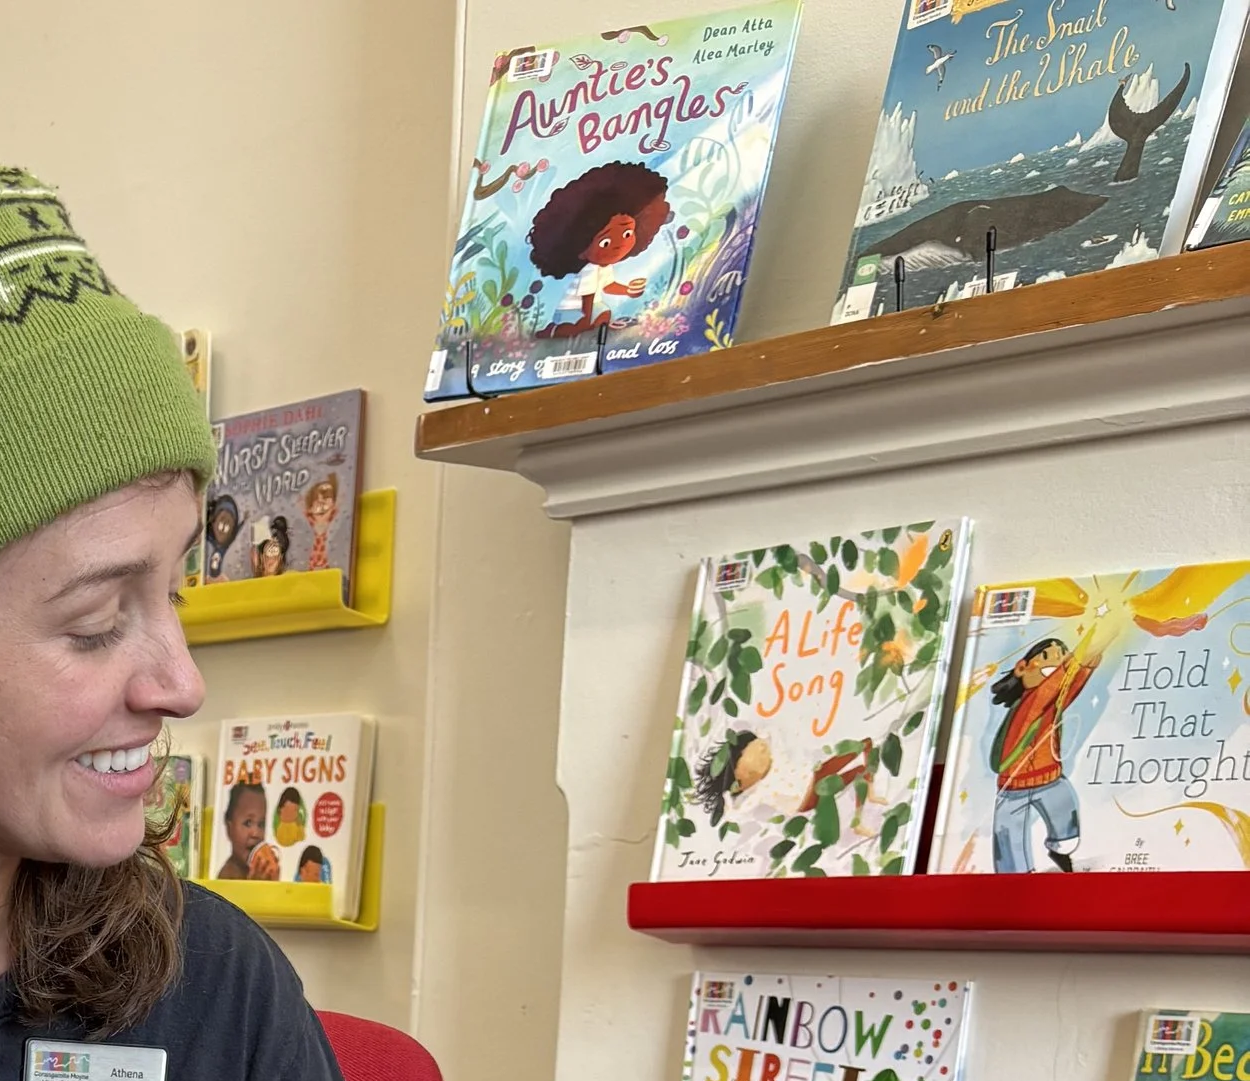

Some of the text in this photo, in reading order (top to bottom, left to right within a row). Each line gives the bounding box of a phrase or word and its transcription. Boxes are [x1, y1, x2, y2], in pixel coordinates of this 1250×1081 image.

[703, 18, 773, 42] Dean Atta
[986, 0, 1107, 65] The Snail
[692, 39, 774, 64] Alea Marley
[945, 27, 1139, 120] and the Whale
[500, 56, 672, 155] Auntie's
[578, 74, 740, 154] Bangles
[606, 338, 679, 361] and loss
[486, 359, 526, 381] story
[255, 469, 310, 507] WORLD
[763, 600, 864, 659] A Life
[1117, 649, 1212, 692] Hold
[756, 662, 844, 737] Song
[1131, 701, 1217, 740] That
[223, 755, 348, 786] BABY SIGNS
[1086, 740, 1250, 798] Thought
[677, 849, 757, 877] Jane Godwin
[1124, 852, 1151, 866] BREE
[700, 992, 894, 1059] RAINBOW
[70, 1072, 89, 1081] Moyne
[110, 1067, 144, 1080] Athena
